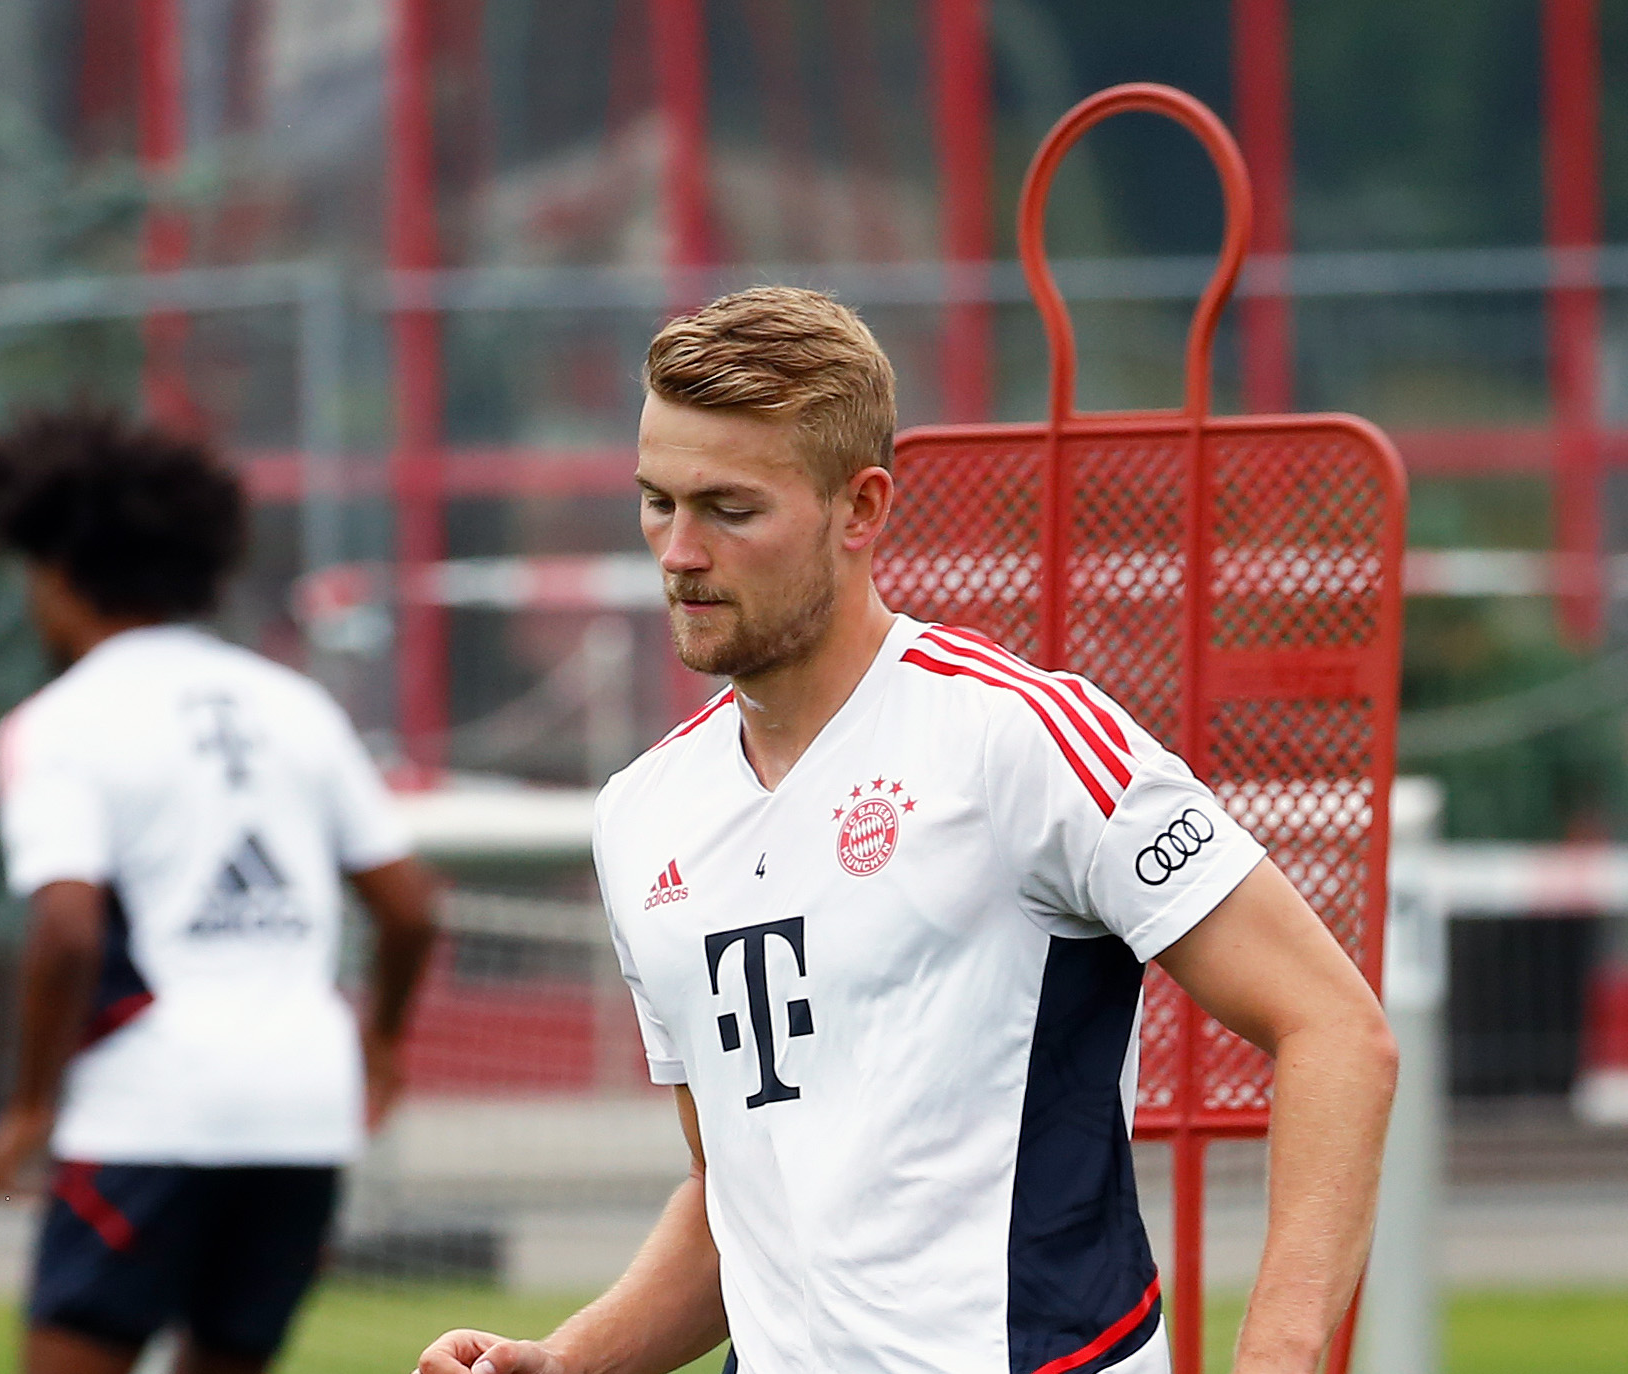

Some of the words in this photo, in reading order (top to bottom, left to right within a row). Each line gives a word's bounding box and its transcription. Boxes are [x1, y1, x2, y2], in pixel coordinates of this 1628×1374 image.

[857, 803, 895, 831] BAYERN
[753, 851, 767, 880] 4
[644, 886, 689, 911] adidas
[704, 916, 815, 1110] T
